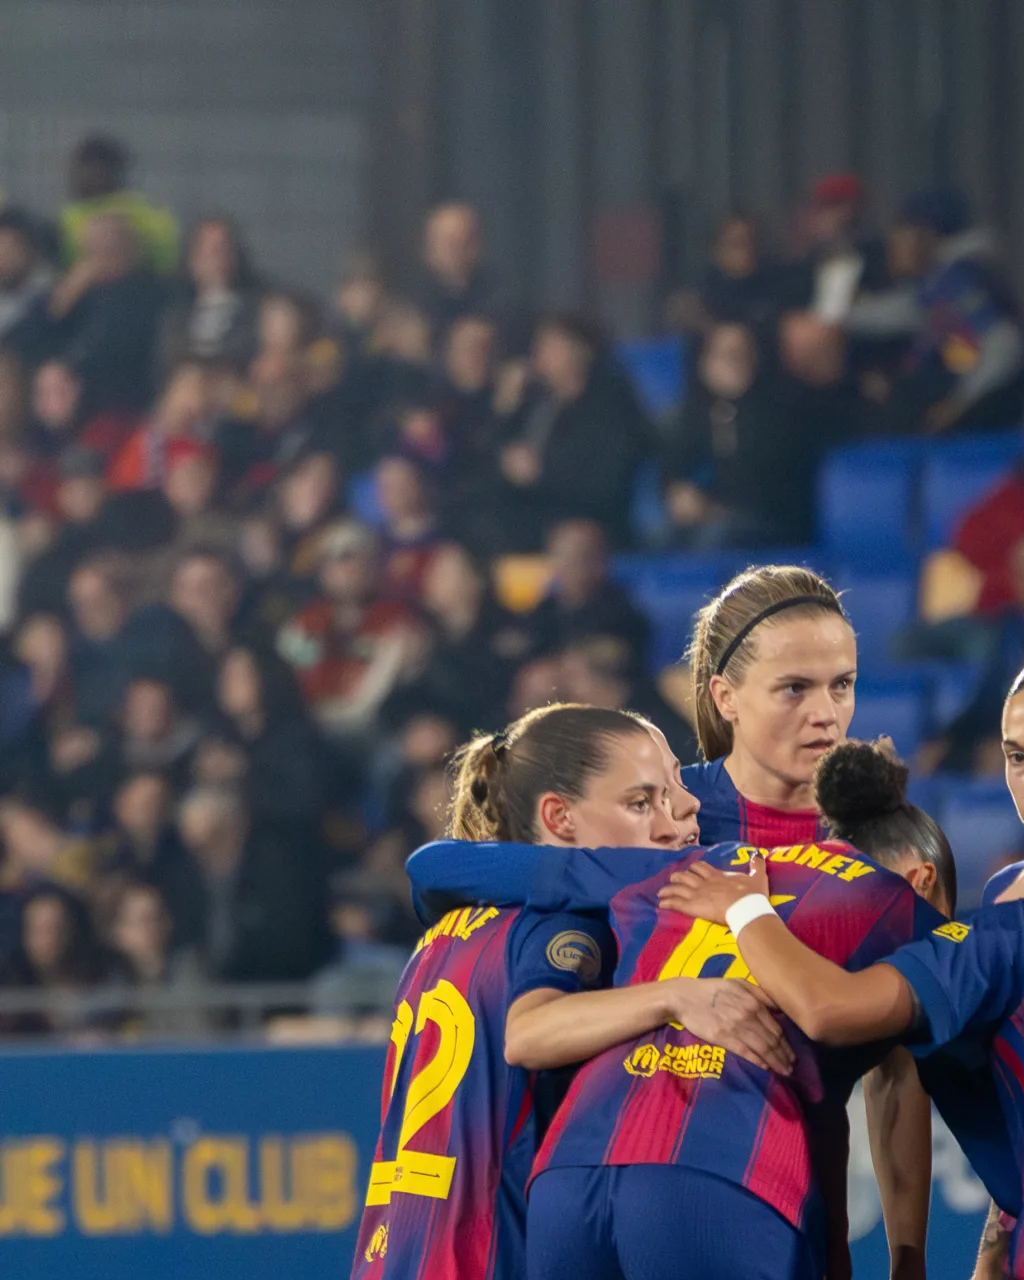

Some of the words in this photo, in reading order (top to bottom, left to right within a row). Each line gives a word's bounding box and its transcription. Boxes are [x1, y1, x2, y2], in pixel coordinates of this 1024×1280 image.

[664, 1043, 726, 1062] UNHCR
[659, 1055, 724, 1074] ACNUR
[74, 1135, 174, 1236] UN
[181, 1131, 357, 1236] CLUB
